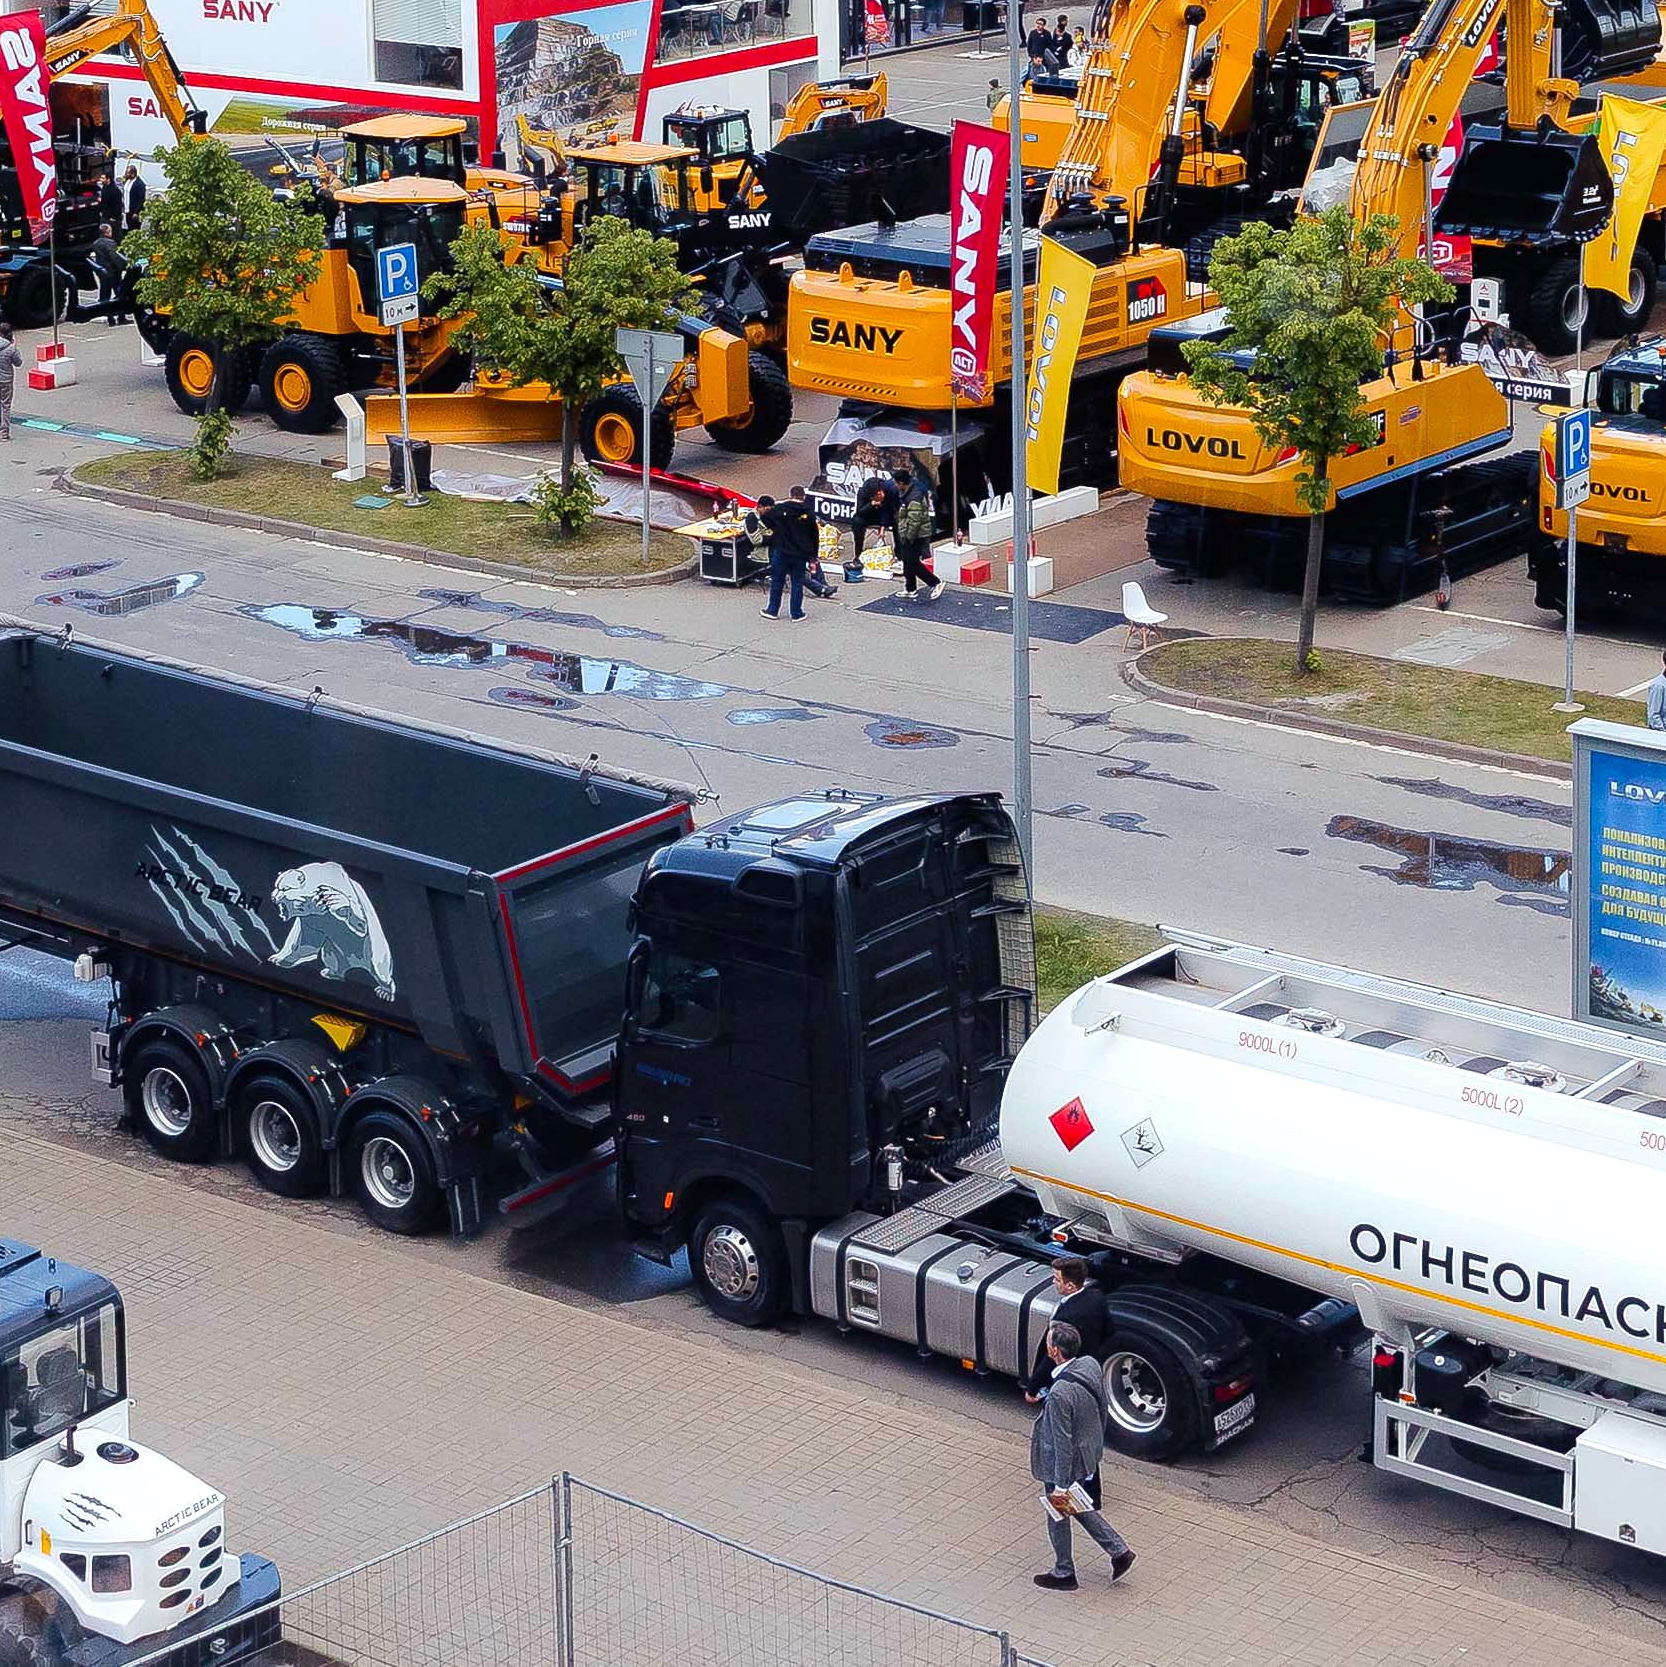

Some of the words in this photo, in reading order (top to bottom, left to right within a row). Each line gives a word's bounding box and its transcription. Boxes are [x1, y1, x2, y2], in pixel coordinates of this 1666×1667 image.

[55, 51, 80, 71] SANY
[728, 213, 771, 229] SANY
[951, 144, 993, 349] SANY
[386, 253, 406, 292] P
[385, 307, 394, 320] 10
[810, 315, 903, 355] SANY
[1507, 381, 1551, 401] серия
[1147, 427, 1246, 460] LOVOL
[1568, 423, 1584, 470] P
[1565, 488, 1573, 501] 10
[1589, 481, 1652, 503] OVOL
[1601, 884, 1658, 905] СОЗДАВАЯ
[1601, 901, 1624, 917] ДЛЯ
[1238, 1032, 1298, 1060] 9000L(1)
[1460, 1086, 1524, 1117] 5000L(2)
[155, 1506, 192, 1537] ARCTIC
[193, 1493, 219, 1518] BEAR
